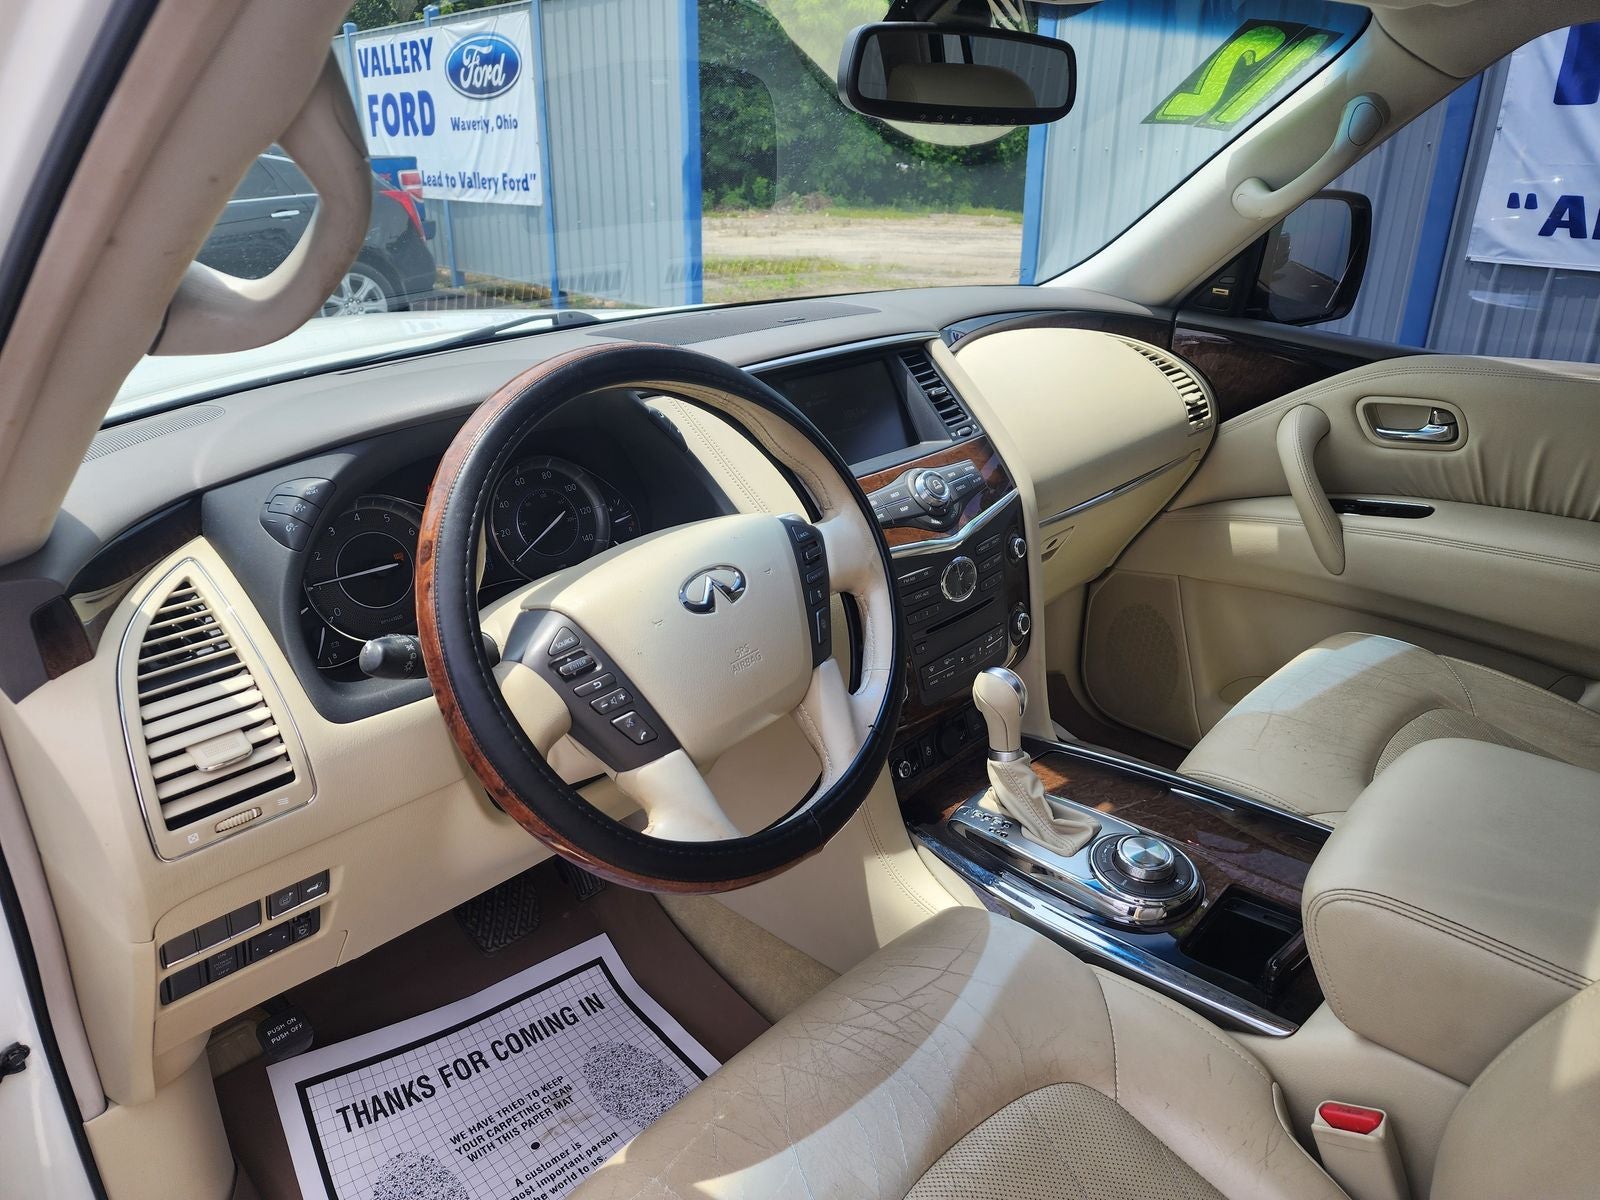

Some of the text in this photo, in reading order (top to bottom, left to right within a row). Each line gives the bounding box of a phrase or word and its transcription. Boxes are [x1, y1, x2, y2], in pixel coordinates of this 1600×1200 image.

[358, 37, 433, 78] VALLERY
[460, 44, 505, 88] Ford
[368, 90, 435, 137] FORD
[496, 114, 518, 130] Ohio
[421, 170, 536, 194] Lead to Vallery Ford"
[514, 477, 526, 486] 60
[541, 471, 552, 480] 80
[565, 483, 577, 492] 100
[500, 500, 510, 509] 40
[580, 506, 592, 515] 120
[353, 513, 361, 522] 4
[383, 513, 391, 523] 5
[328, 526, 336, 536] 3
[408, 527, 415, 536] 6
[500, 528, 511, 538] 20
[581, 533, 594, 542] 140
[314, 551, 322, 561] 2
[334, 607, 341, 616] 0
[555, 637, 575, 649] SOURCE
[735, 643, 750, 658] SRS
[569, 659, 587, 670] ENTER
[731, 653, 762, 674] AIRBAG
[267, 1016, 297, 1037] PUSH ON
[271, 1022, 303, 1045] PUSH OFF
[336, 992, 605, 1133] THANKS FOR COMING IN
[449, 1075, 565, 1146] WE HAVE TRIED TO KEEP
[455, 1084, 573, 1157] YOUR CARPETING CLEAN
[466, 1095, 575, 1163] WITH THIS PAPER MAT
[515, 1141, 582, 1187] A customer is
[537, 1153, 585, 1189] important
[585, 1132, 618, 1158] person
[549, 1172, 578, 1195] world
[578, 1164, 590, 1175] to
